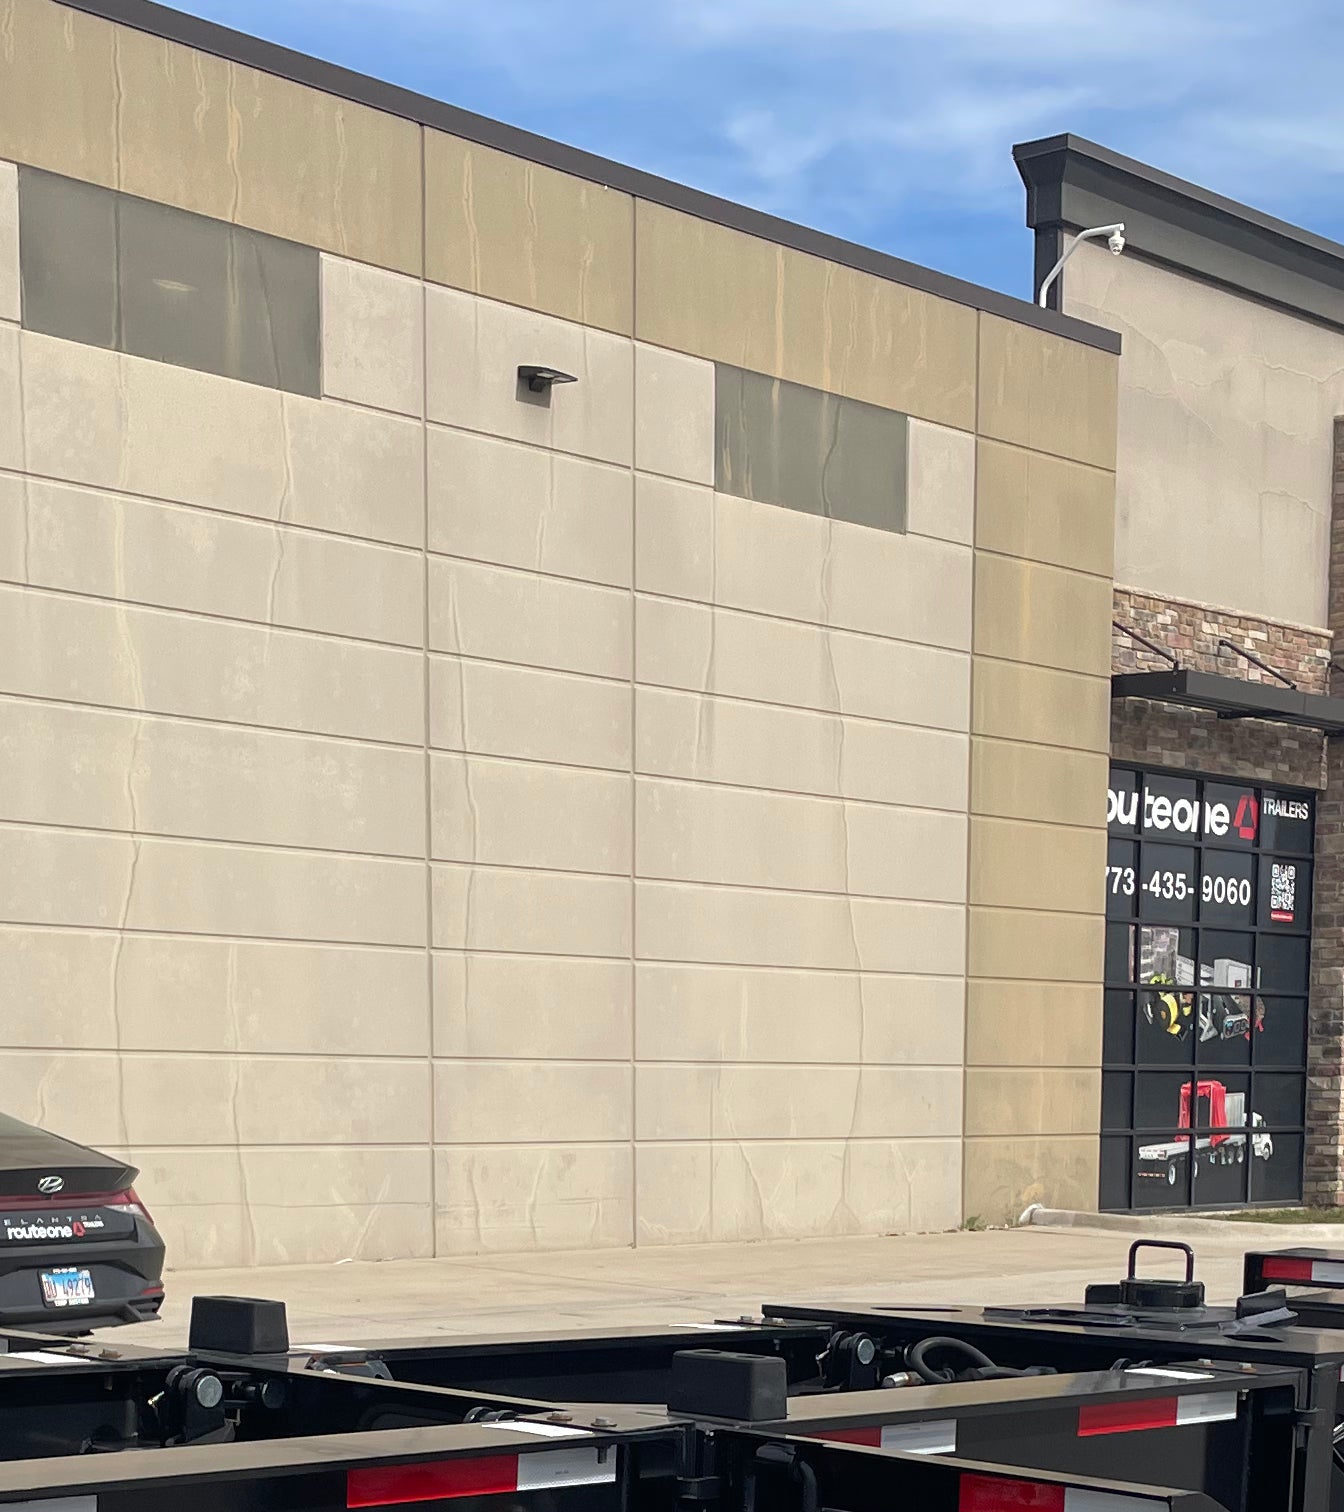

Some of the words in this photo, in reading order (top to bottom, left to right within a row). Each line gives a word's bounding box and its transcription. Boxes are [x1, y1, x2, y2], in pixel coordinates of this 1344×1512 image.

[1107, 786, 1230, 836] outeone
[1263, 798, 1309, 820] TRAILERS
[1105, 866, 1251, 906] 73-435-9060
[7, 1224, 73, 1239] routeone
